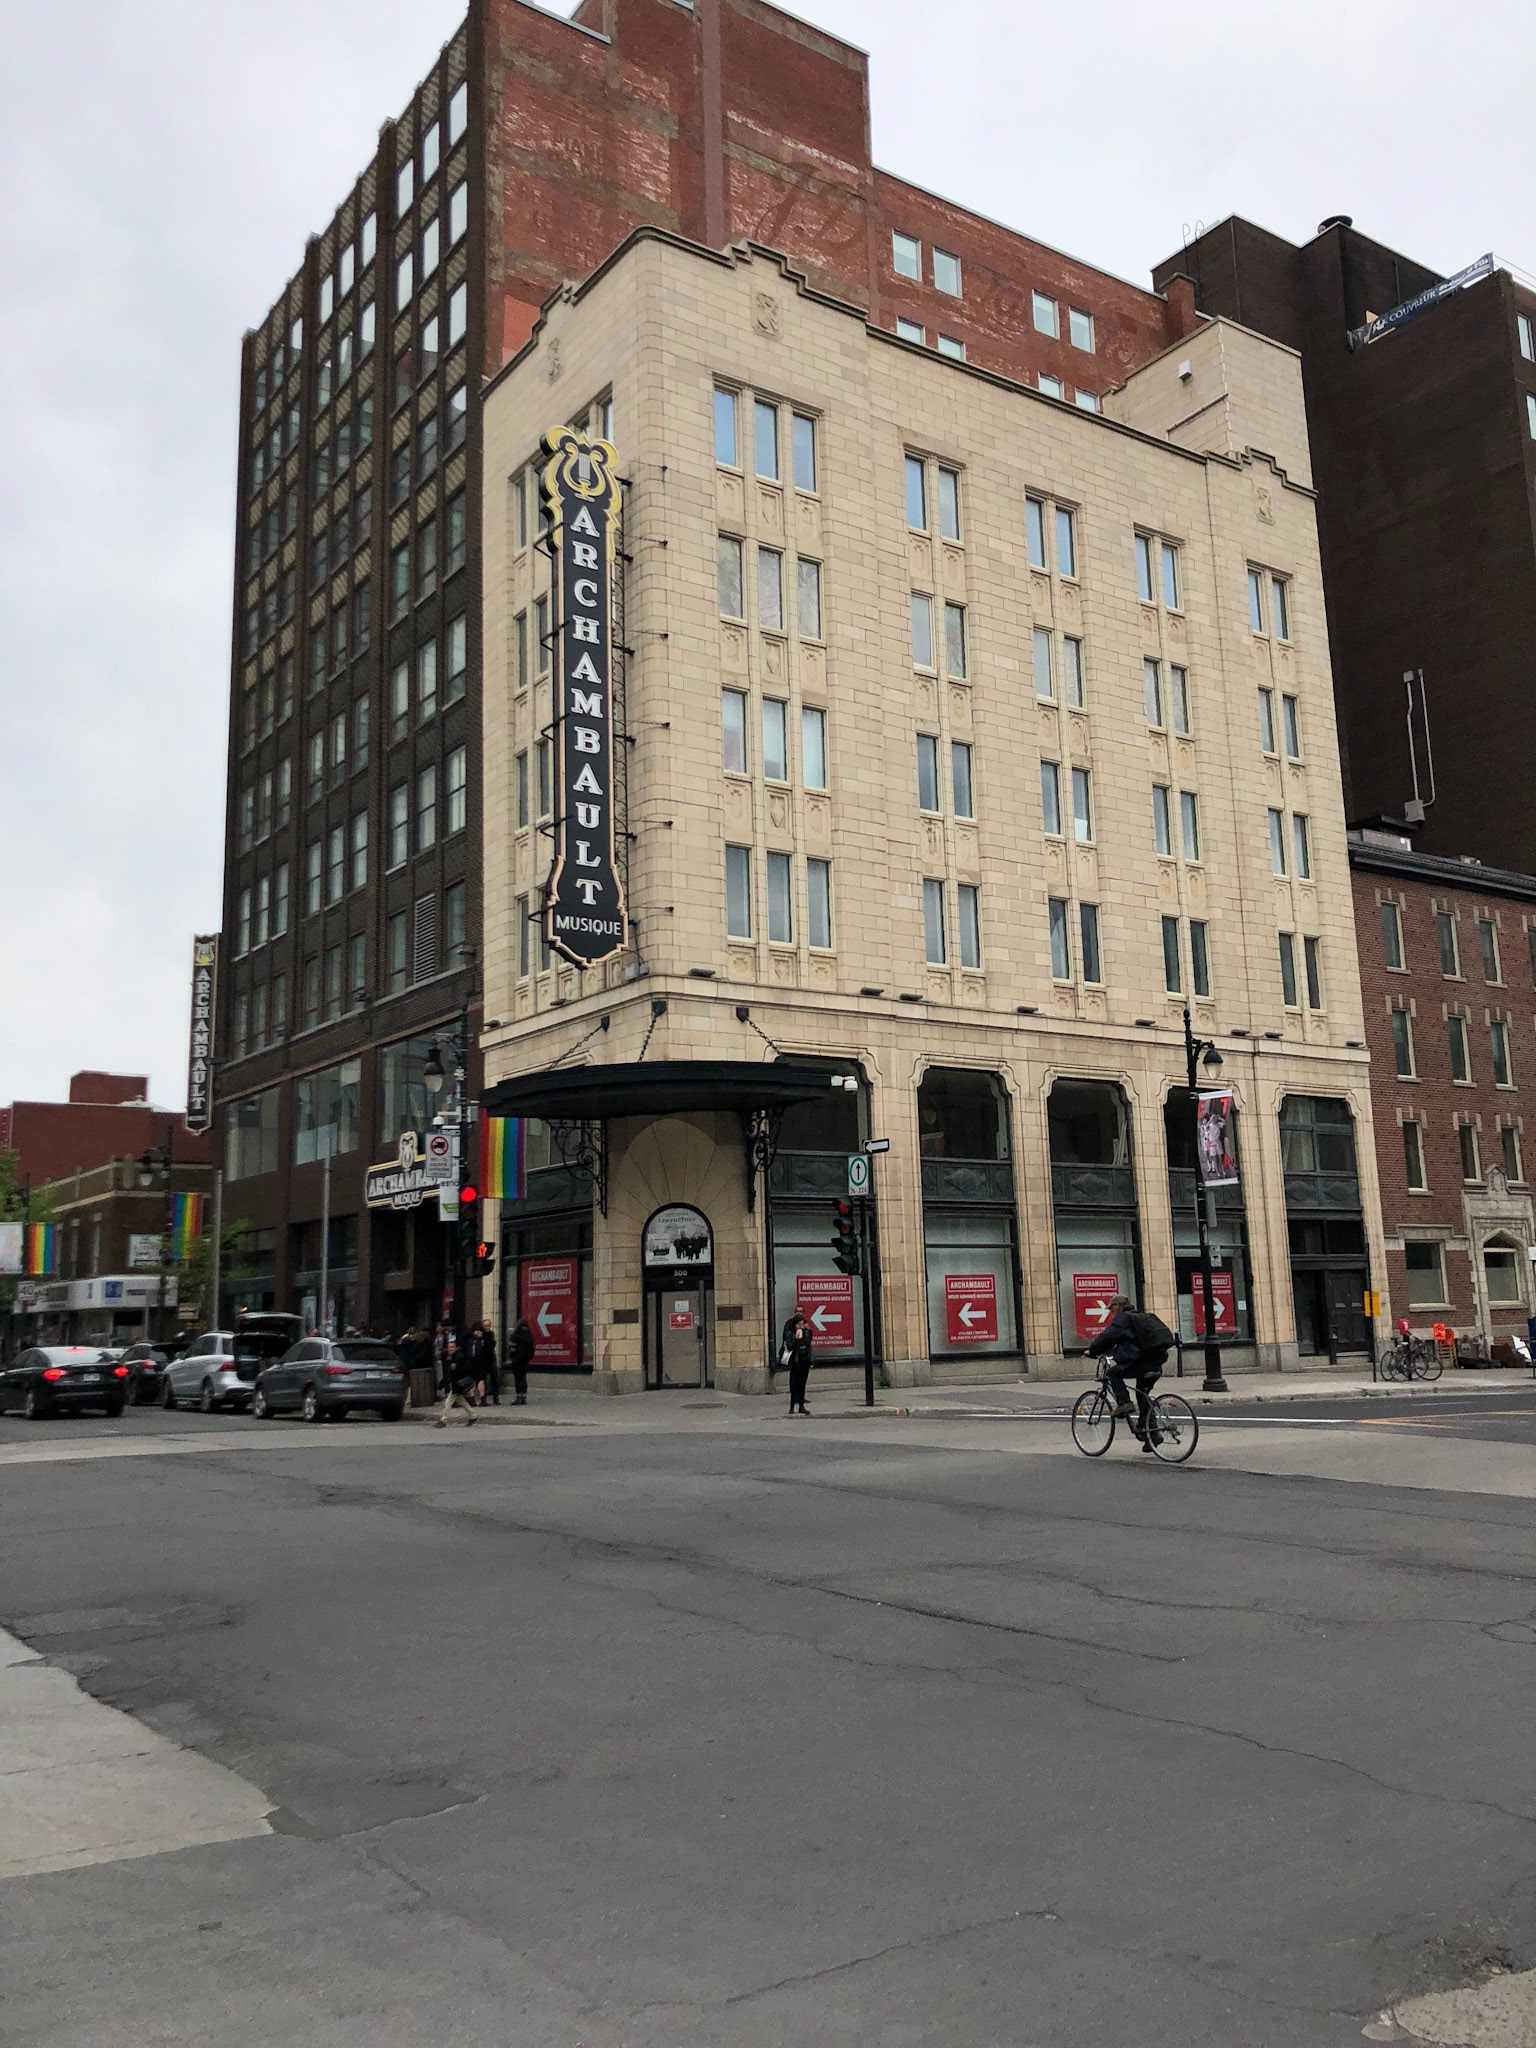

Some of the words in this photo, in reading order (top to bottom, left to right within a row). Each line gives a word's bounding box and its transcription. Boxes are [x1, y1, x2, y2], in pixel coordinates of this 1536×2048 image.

[570, 505, 603, 906] ARCHAMBAULT
[555, 913, 622, 938] MUSIQUE
[192, 967, 212, 1110] ARCHAMBAULT
[394, 1191, 421, 1205] MUSIQUE
[673, 1269, 688, 1277] 500
[802, 1282, 848, 1291] ARCHAMBAULT
[950, 1280, 991, 1289] ARCHAMBAULT
[1078, 1279, 1115, 1288] ARCHAMBAULT
